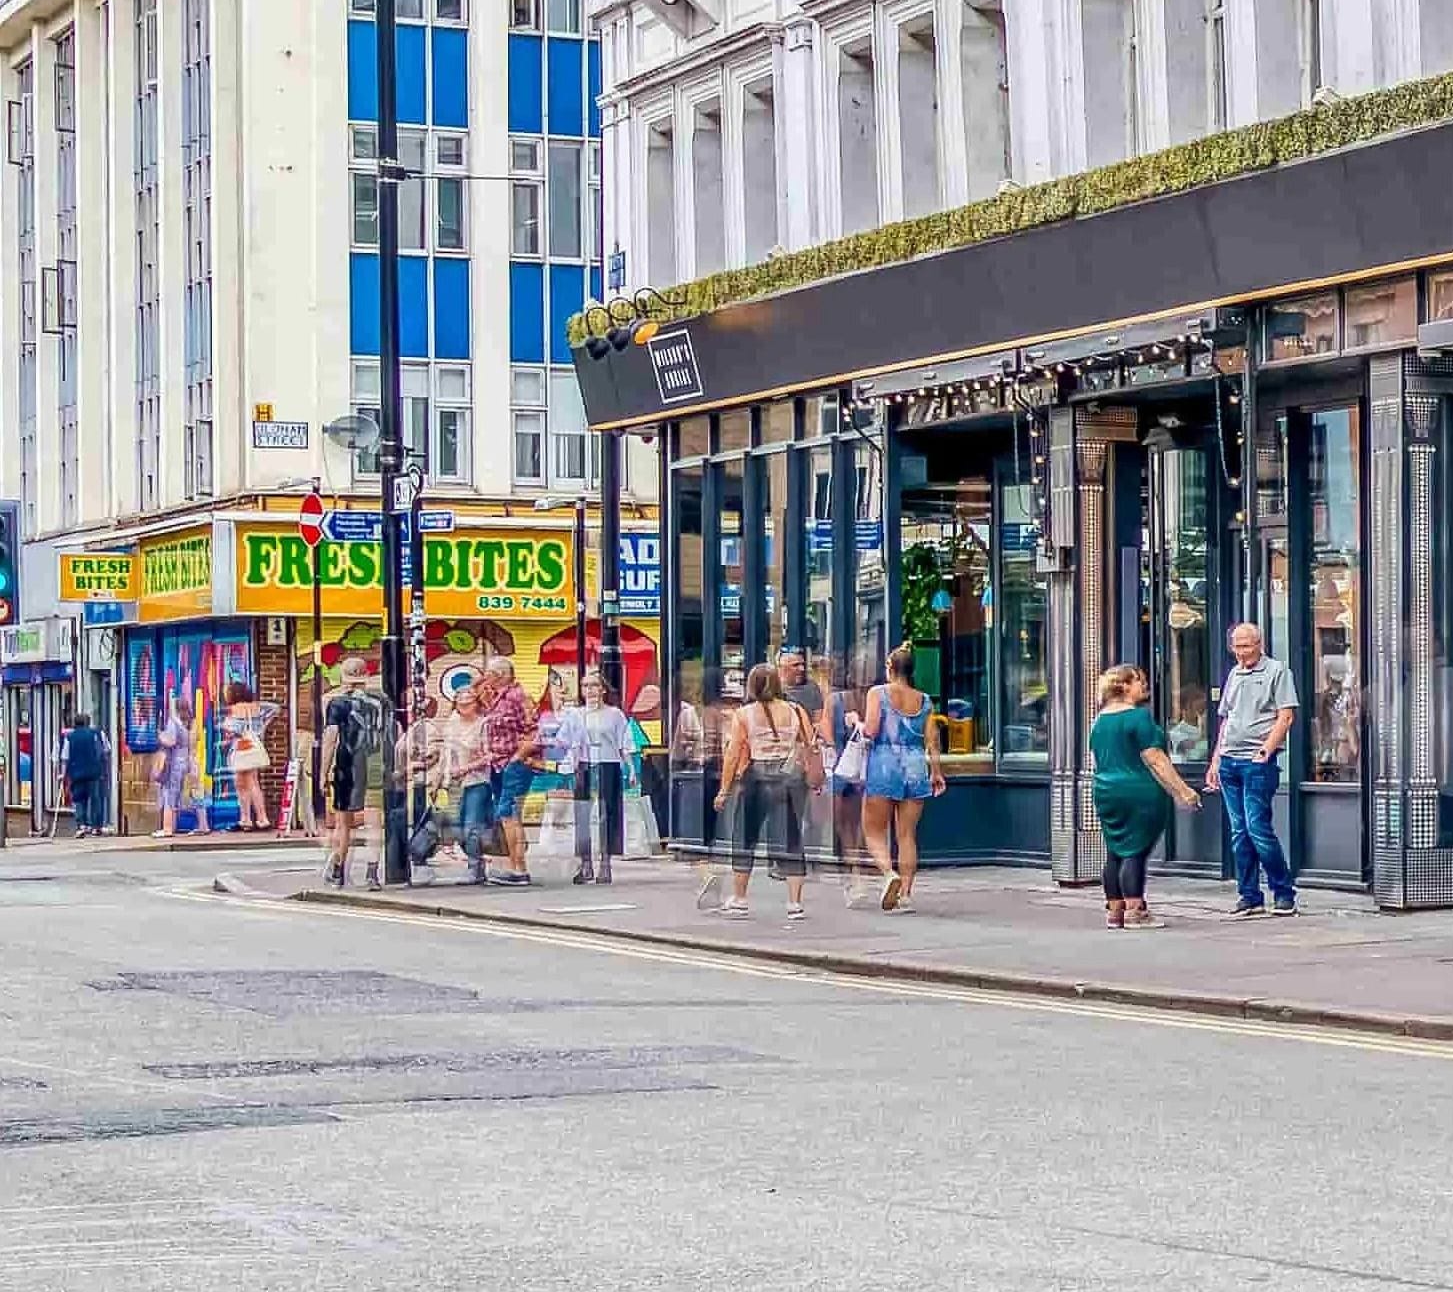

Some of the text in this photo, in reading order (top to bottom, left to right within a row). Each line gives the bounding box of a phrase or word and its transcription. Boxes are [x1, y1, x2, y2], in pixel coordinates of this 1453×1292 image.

[72, 560, 130, 573] FRESH
[246, 536, 385, 586] FRES
[425, 540, 564, 590] BITES
[75, 576, 128, 589] BITES
[479, 596, 567, 609] 839 7444
